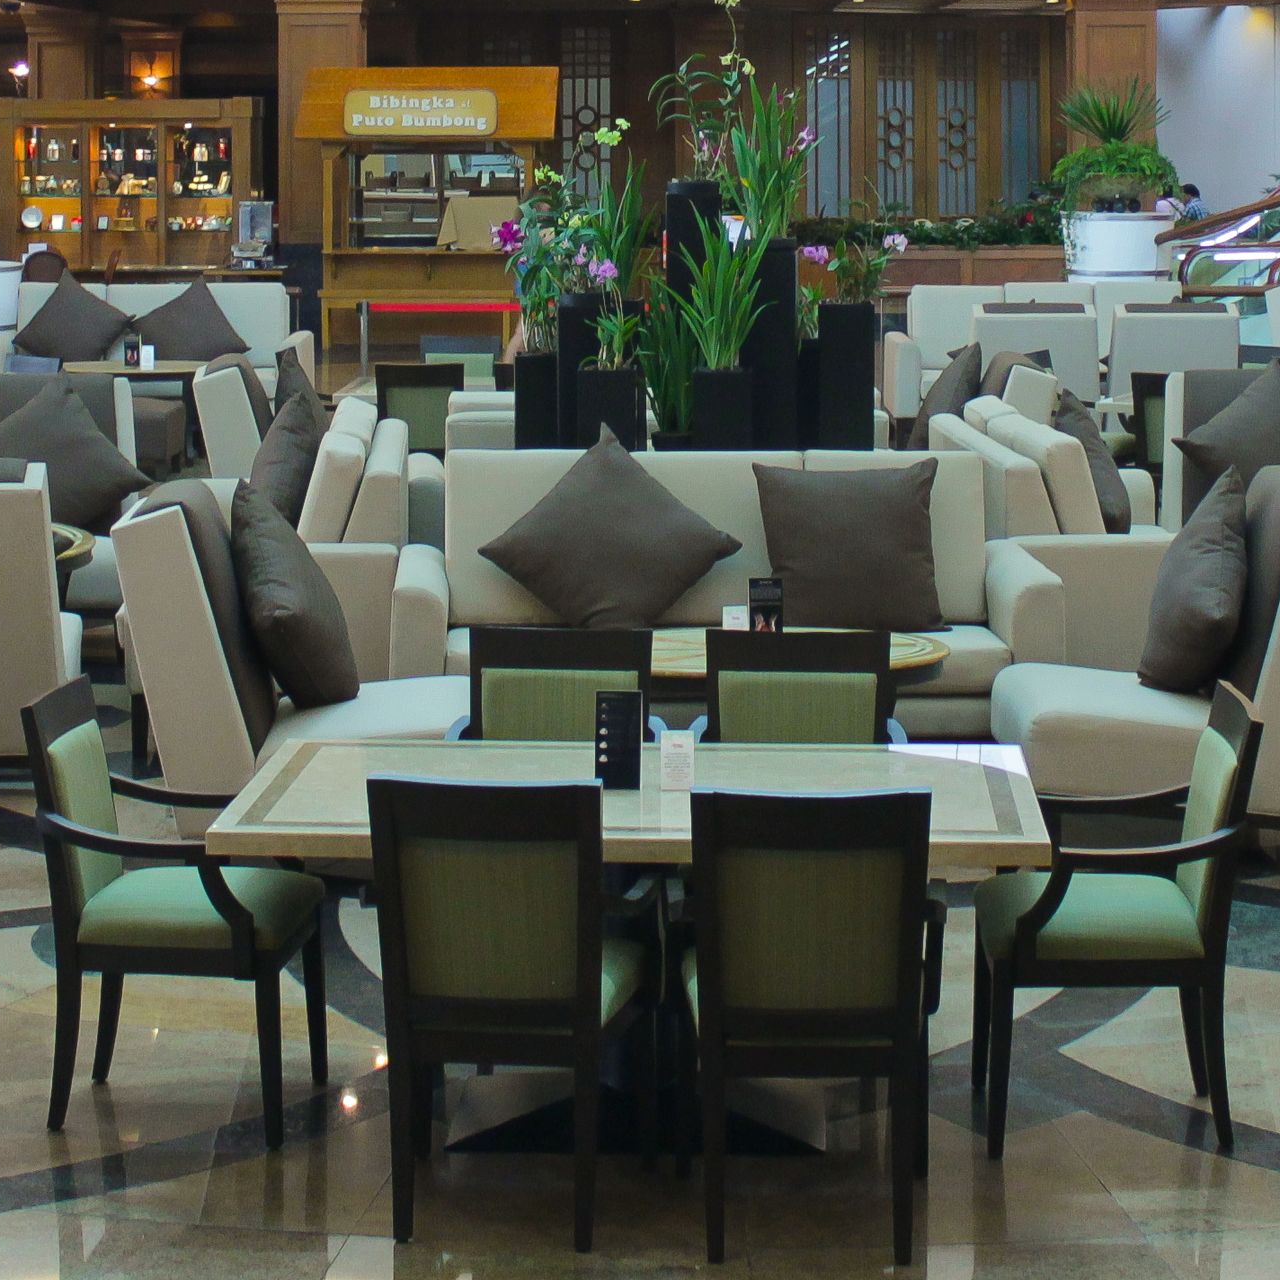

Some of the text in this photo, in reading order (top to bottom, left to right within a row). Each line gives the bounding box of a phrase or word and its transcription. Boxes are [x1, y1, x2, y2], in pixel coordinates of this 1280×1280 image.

[369, 95, 455, 112] Bibingka
[351, 113, 488, 131] Puto Bumbong
